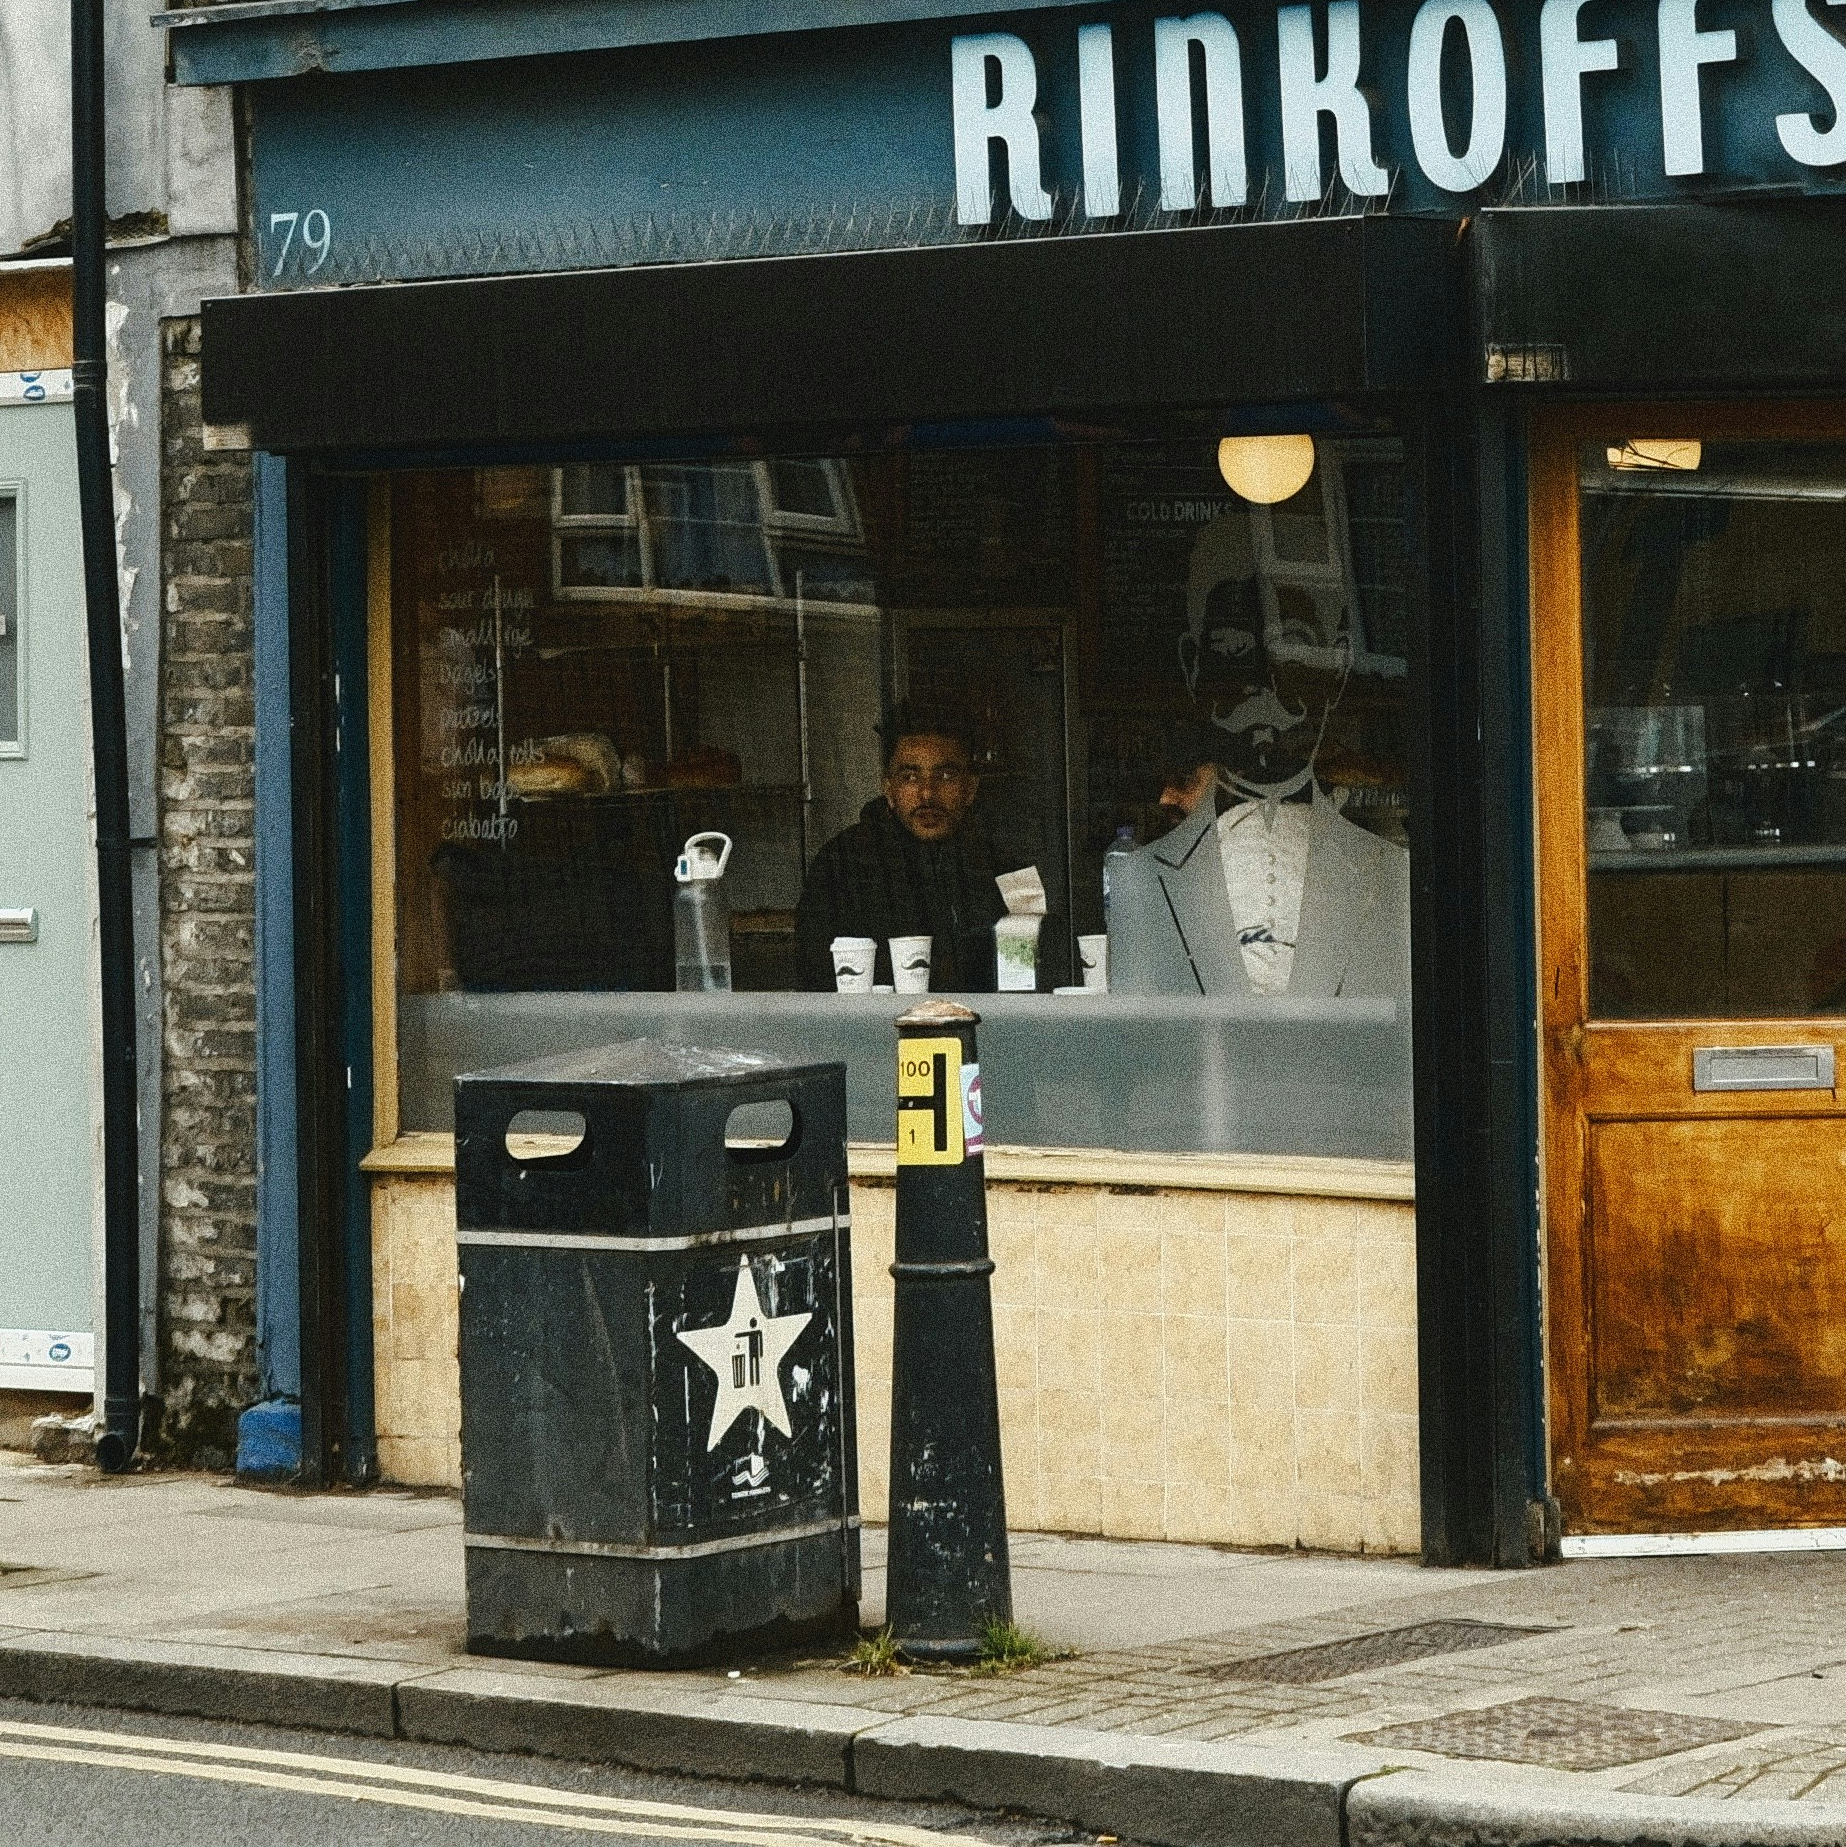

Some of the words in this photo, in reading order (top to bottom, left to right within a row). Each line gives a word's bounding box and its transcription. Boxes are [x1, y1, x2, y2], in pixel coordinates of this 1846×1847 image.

[269, 208, 332, 278] 79
[900, 1060, 931, 1077] 100
[908, 1128, 916, 1146] 1
